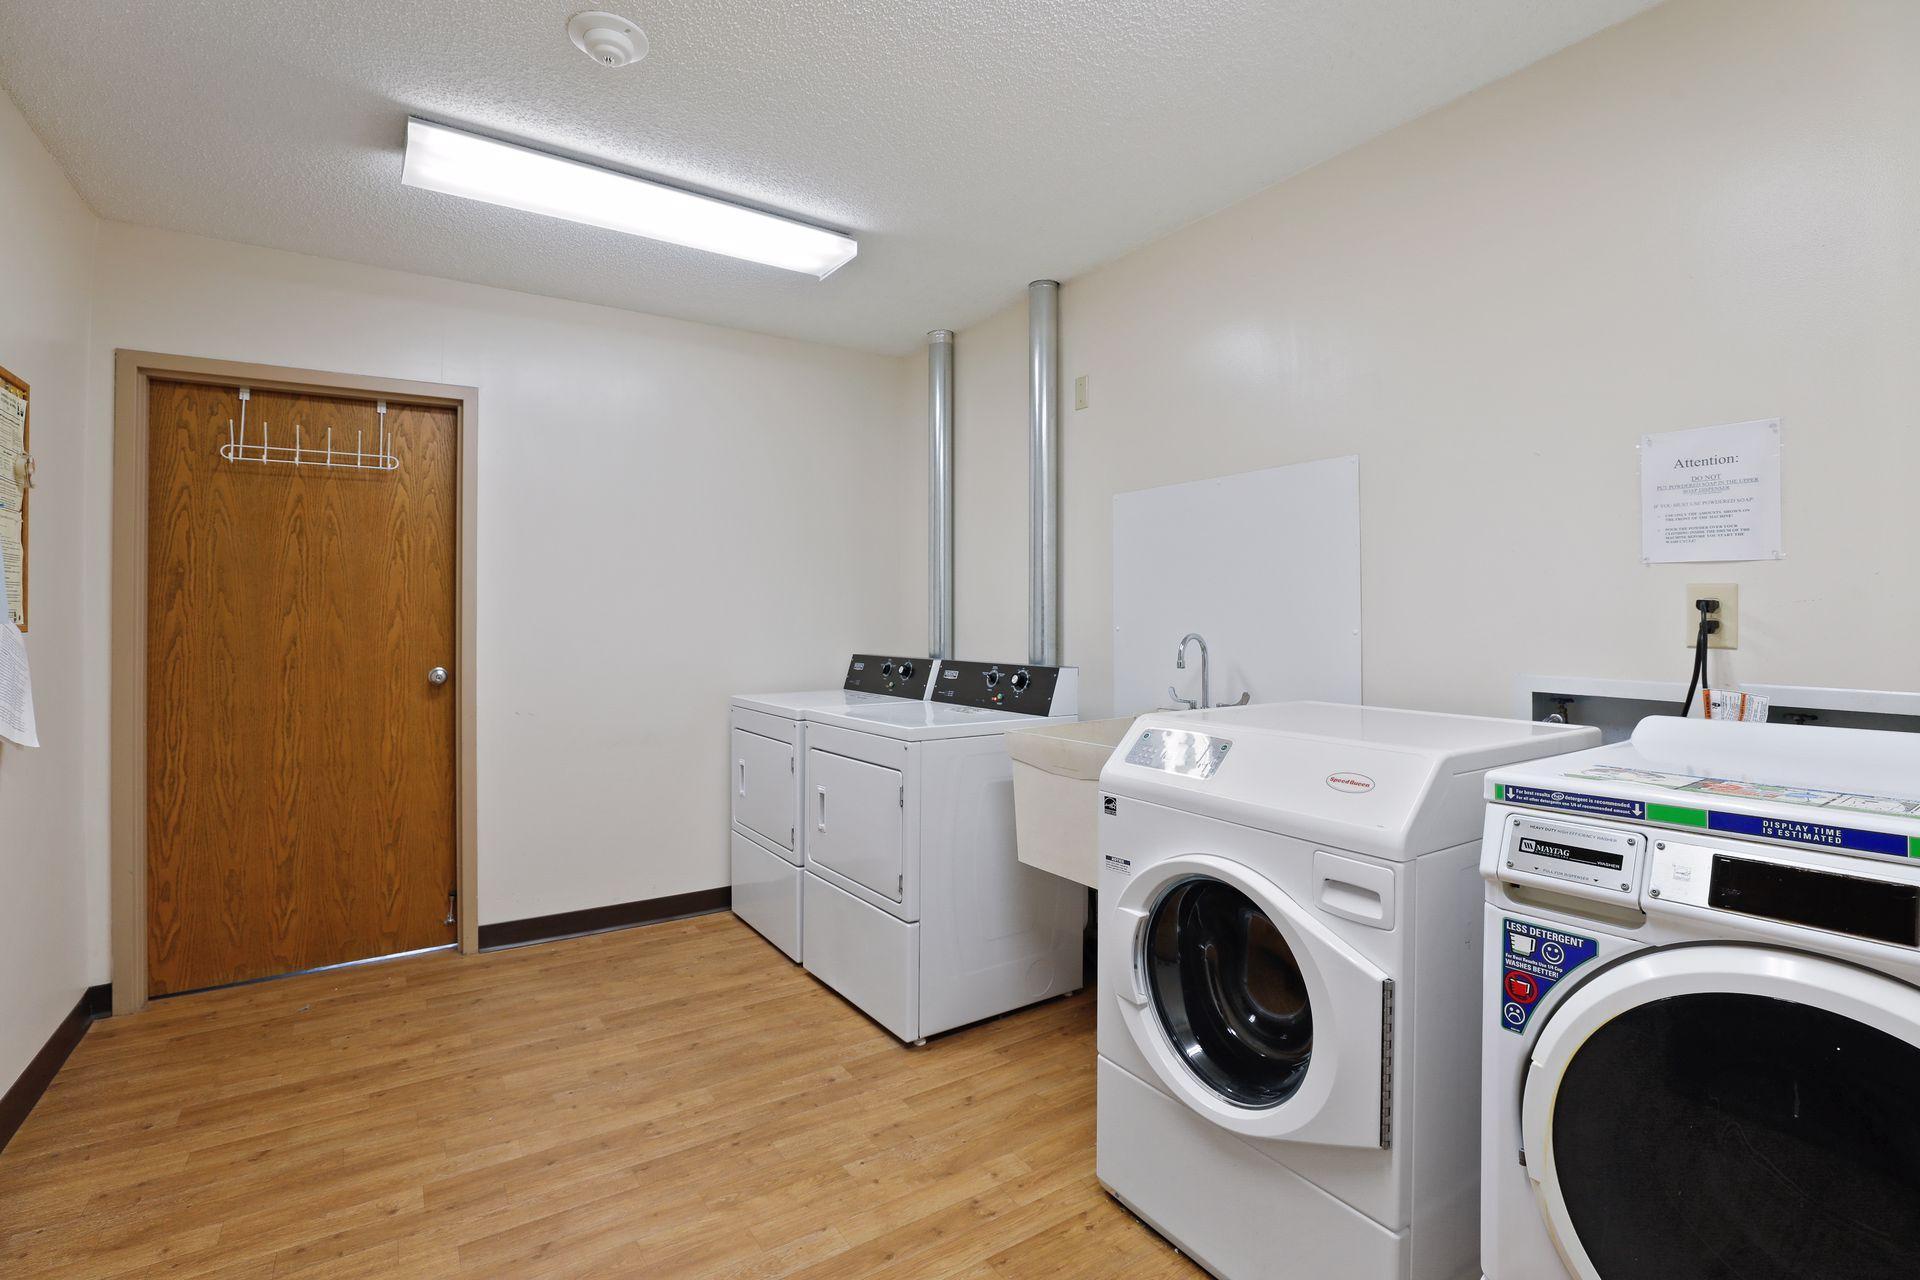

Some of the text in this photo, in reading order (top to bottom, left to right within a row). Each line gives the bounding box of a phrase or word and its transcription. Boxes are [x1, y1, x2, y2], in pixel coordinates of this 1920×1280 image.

[1674, 454, 1739, 469] Attention:
[1564, 795, 1589, 804] detergent
[1594, 798, 1632, 809] recommended.
[1763, 820, 1842, 837] DISPLAY TIME
[1777, 829, 1842, 844] ESTIMATED
[1534, 844, 1571, 857] MAYTAG
[1596, 860, 1621, 869] WASHER
[1506, 921, 1584, 948] LESS DETERGENT
[1505, 958, 1559, 979] WASHES BETTER!
